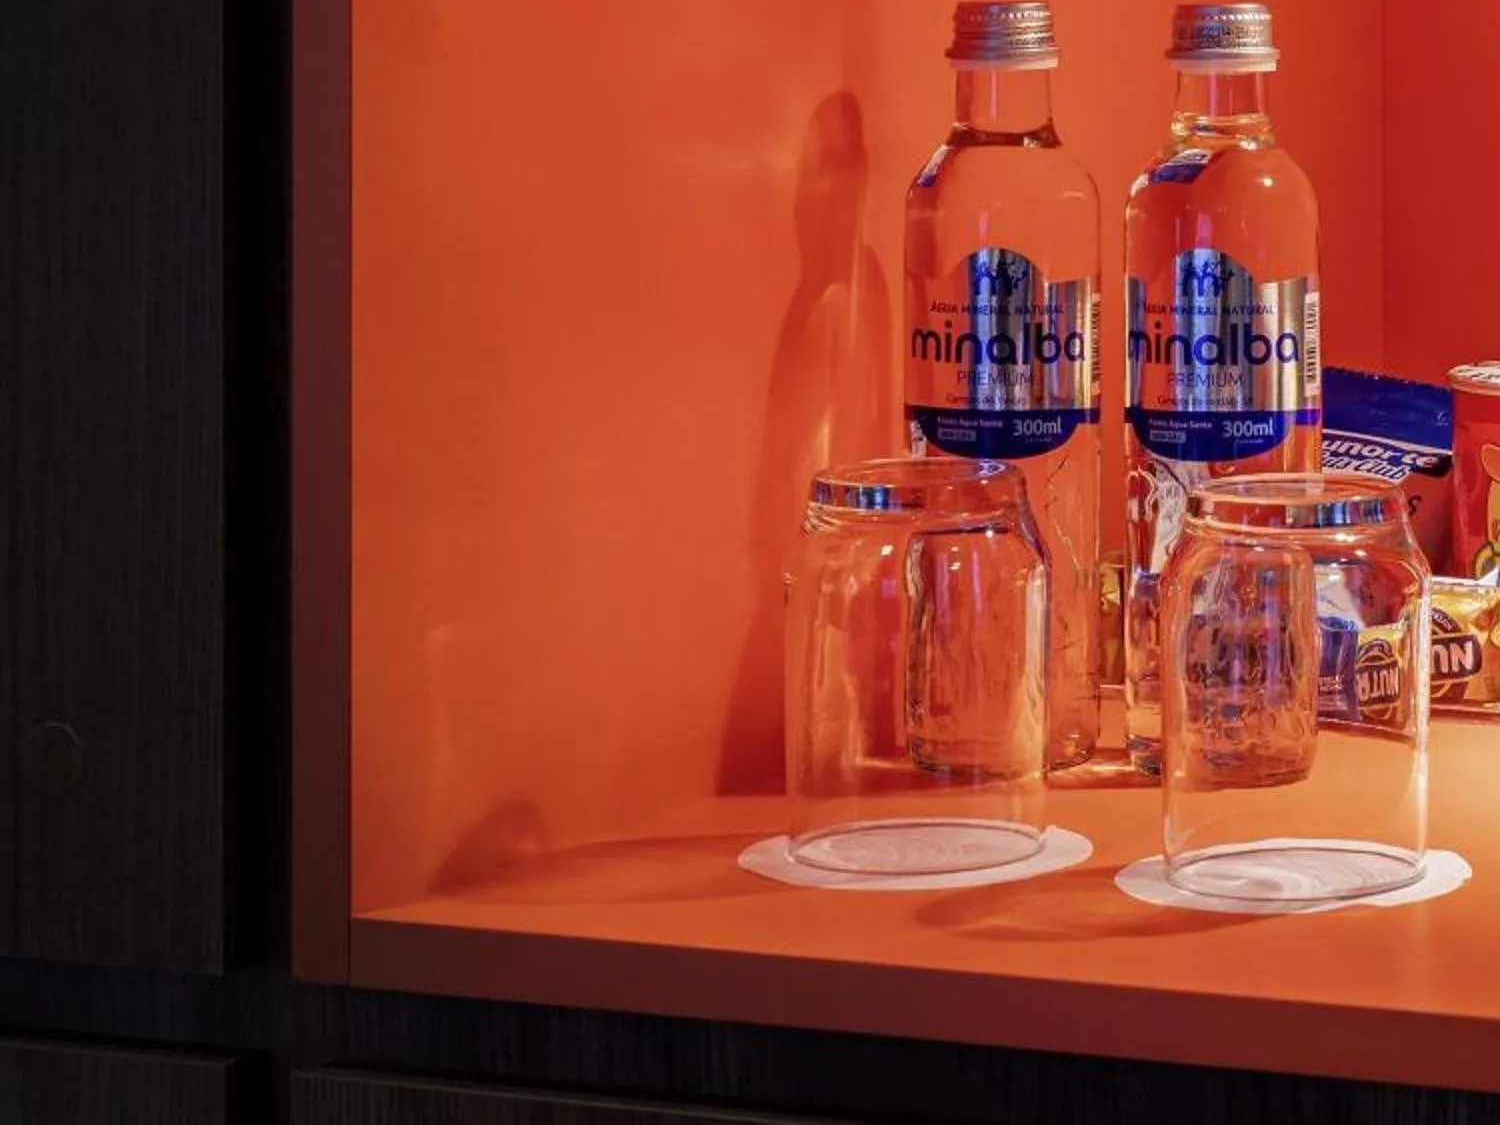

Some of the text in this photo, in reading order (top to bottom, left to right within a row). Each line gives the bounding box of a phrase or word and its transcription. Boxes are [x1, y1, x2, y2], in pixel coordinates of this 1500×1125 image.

[911, 320, 1086, 365] minalba
[1012, 416, 1062, 437] 300ml
[1221, 418, 1275, 439] 300ml
